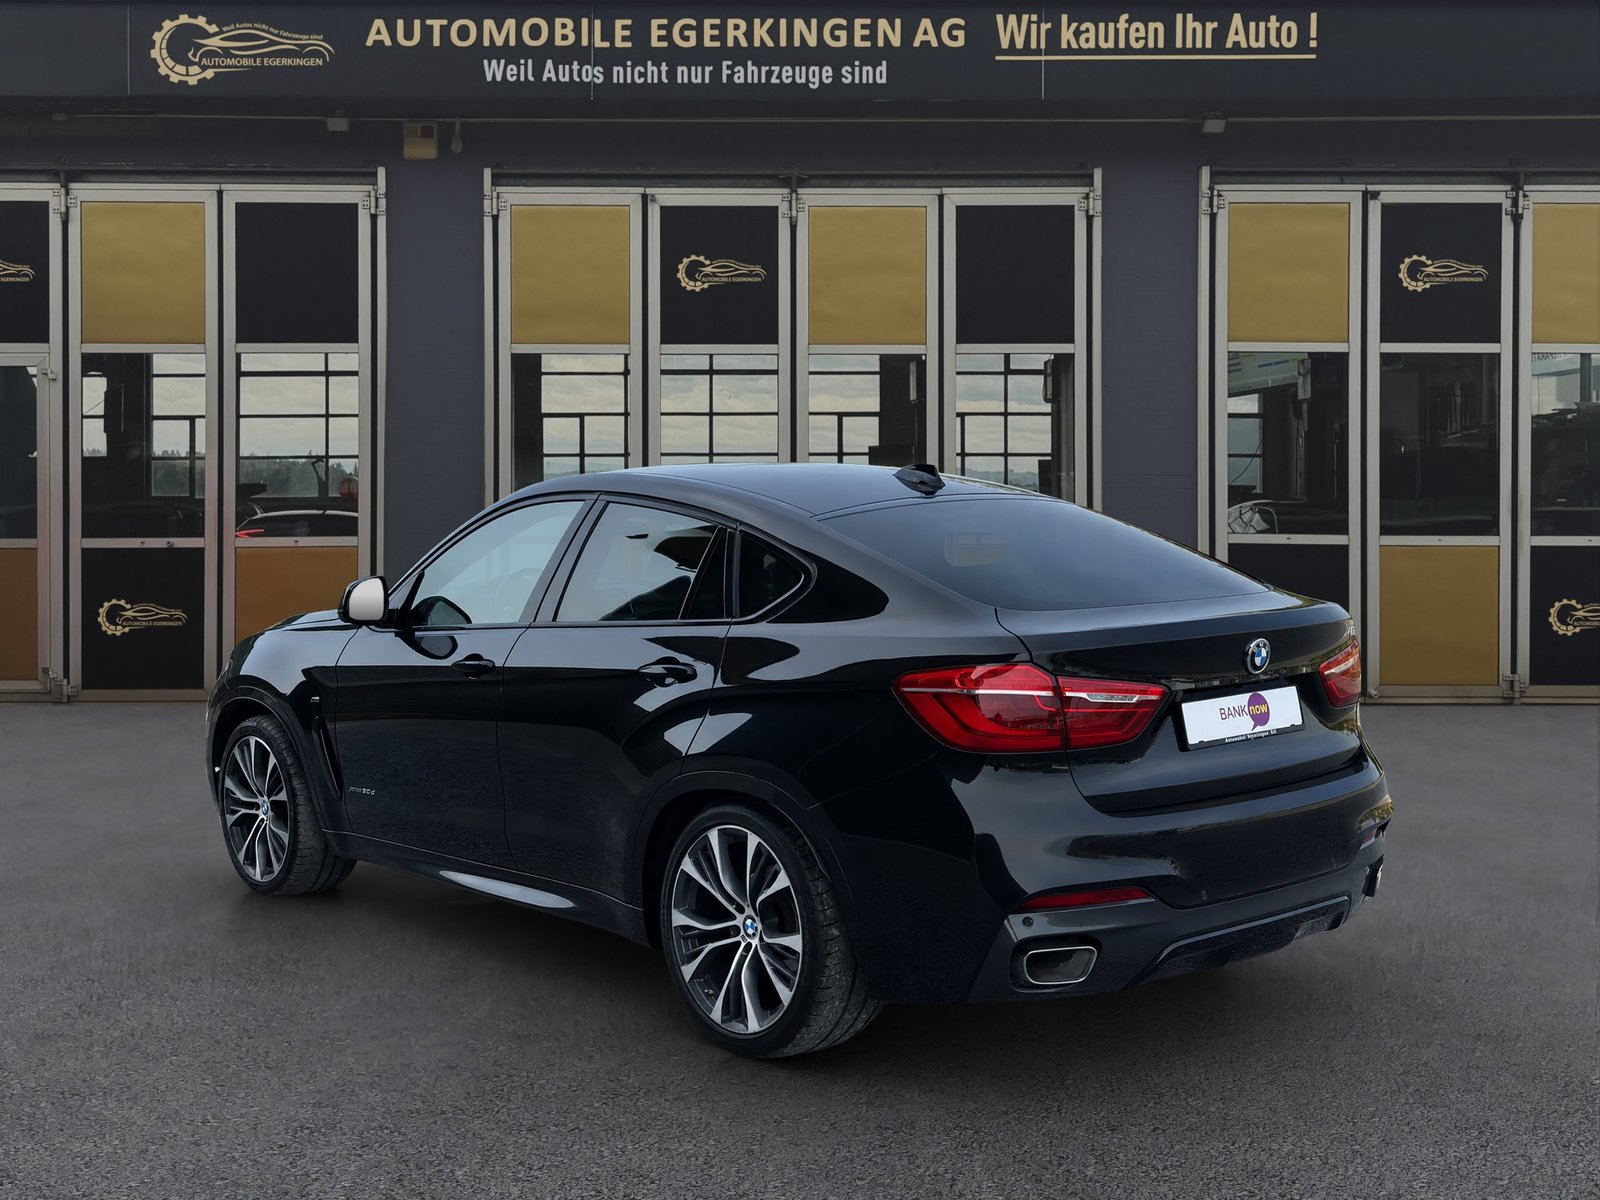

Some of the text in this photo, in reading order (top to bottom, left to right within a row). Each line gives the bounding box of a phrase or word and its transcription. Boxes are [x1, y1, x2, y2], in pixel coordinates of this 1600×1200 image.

[253, 22, 269, 31] nicht
[279, 30, 309, 40] Fahrzeuge
[365, 17, 966, 48] AUTOMOBILE EGERKINGEN AG
[996, 14, 1052, 49] Wir
[1060, 13, 1165, 49] kaufen
[1175, 13, 1218, 49] Ihr
[1225, 12, 1298, 49] Auto
[201, 57, 323, 66] AUTOMOBILE EGERKINGEN
[483, 59, 887, 89] Weil Autos nicht nur Fahrzeuge sind
[1219, 703, 1268, 720] BANK now
